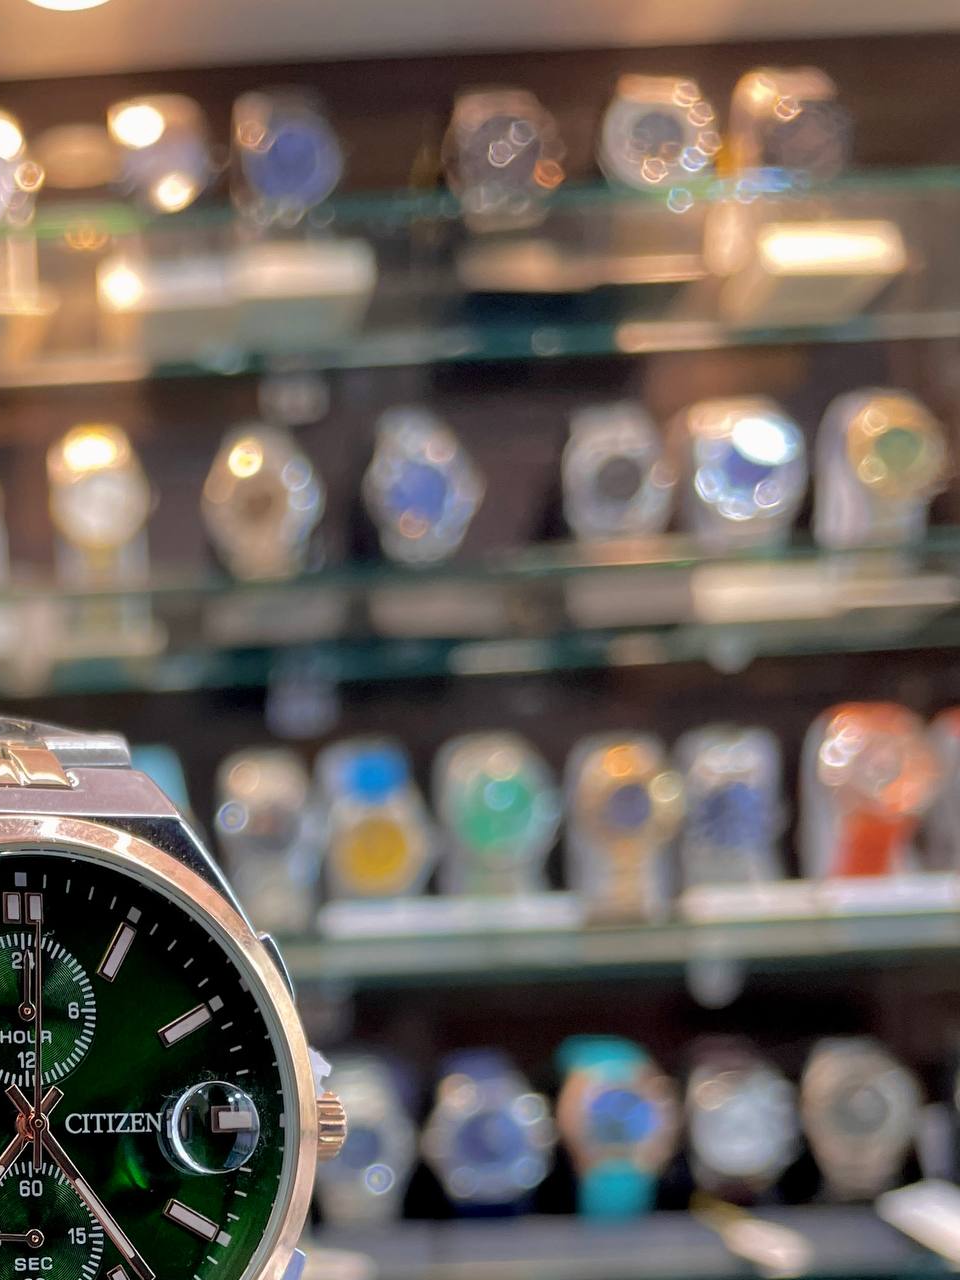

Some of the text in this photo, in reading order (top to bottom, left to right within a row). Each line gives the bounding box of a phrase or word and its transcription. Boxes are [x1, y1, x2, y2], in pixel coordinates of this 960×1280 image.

[68, 1002, 80, 1019] 6
[0, 1030, 52, 1044] HOUR
[17, 1051, 36, 1069] 12
[65, 1112, 164, 1134] CITIZEN
[19, 1180, 43, 1197] 60
[68, 1227, 86, 1245] 15
[14, 1257, 53, 1271] SEC
